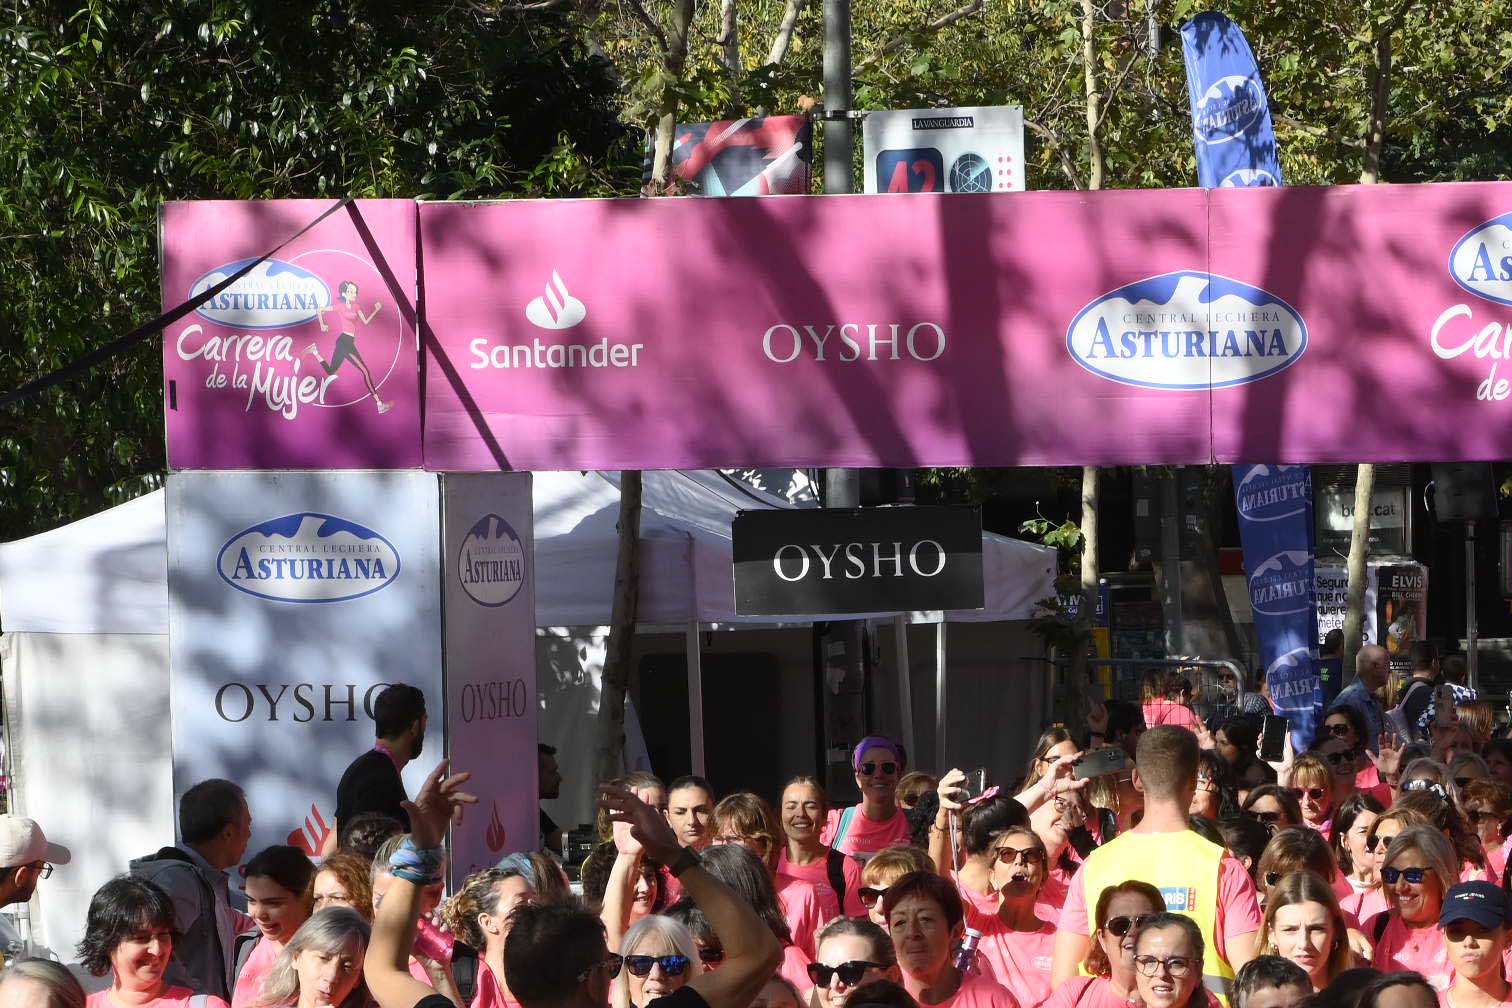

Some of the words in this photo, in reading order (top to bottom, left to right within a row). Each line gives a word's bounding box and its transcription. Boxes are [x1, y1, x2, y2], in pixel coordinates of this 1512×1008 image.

[924, 117, 972, 129] VANGUARDIA
[1122, 311, 1200, 324] CENTRAL
[1204, 311, 1281, 323] LECHERA
[176, 324, 293, 361] Carrera
[469, 335, 644, 370] Santander
[761, 321, 947, 364] OYSHO
[1086, 315, 1288, 358] ASTURIANA
[206, 362, 227, 389] de
[232, 362, 248, 389] la
[245, 358, 338, 420] Mujer
[1475, 362, 1510, 401] de
[231, 545, 388, 581] ASTURIANA
[258, 543, 318, 553] CENTRAL
[322, 543, 381, 553] LECHERA
[463, 548, 522, 585] ASTURIANA
[773, 540, 947, 583] OYSHO
[1391, 575, 1423, 588] ELVIS
[461, 678, 527, 724] OYSHO
